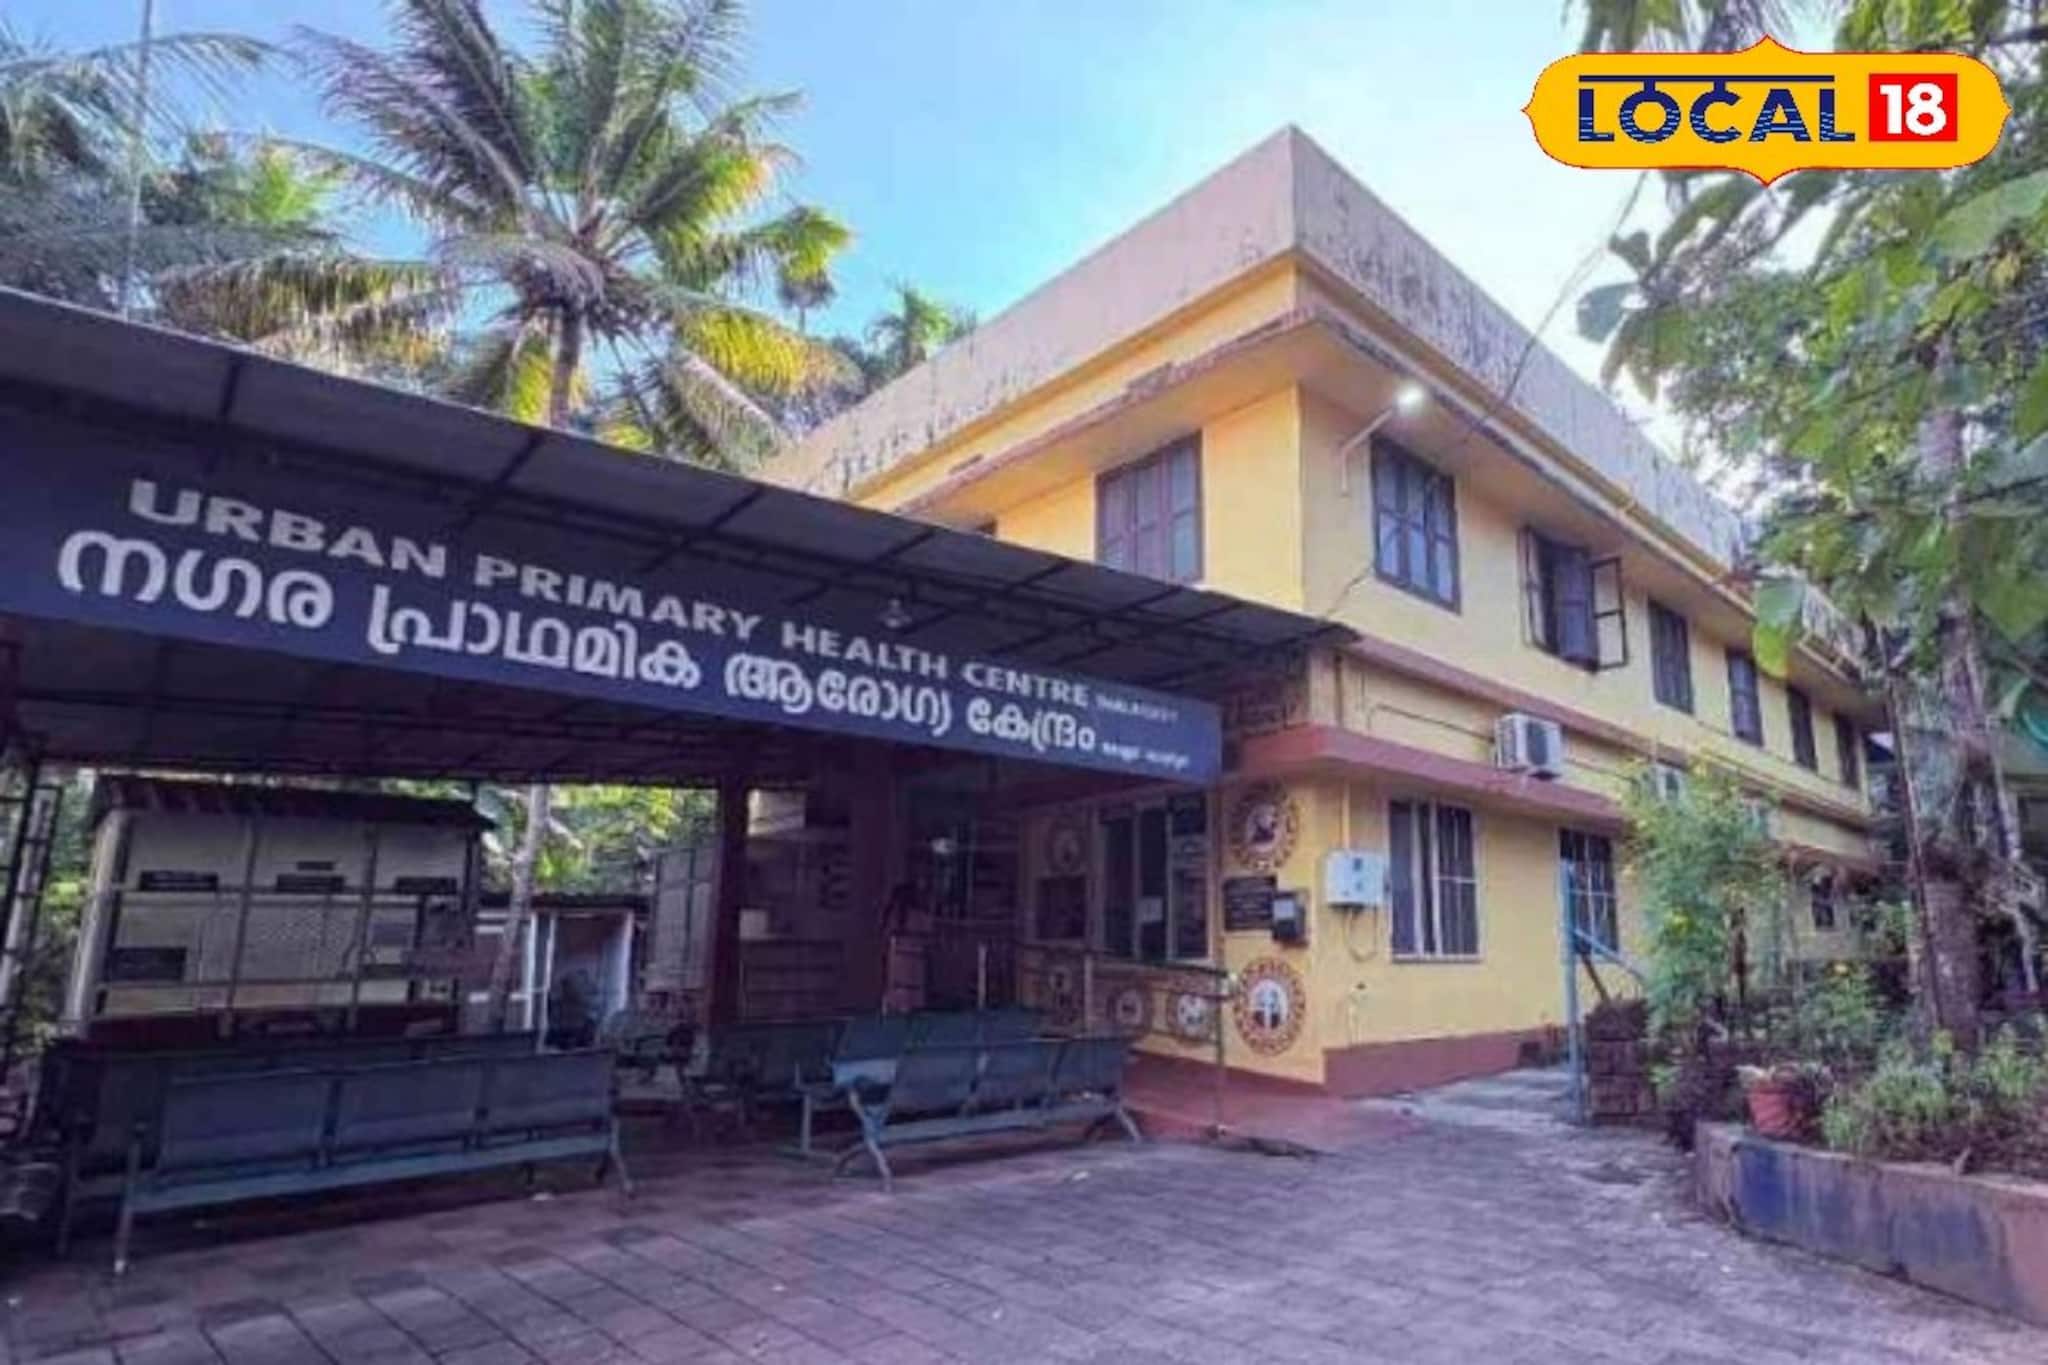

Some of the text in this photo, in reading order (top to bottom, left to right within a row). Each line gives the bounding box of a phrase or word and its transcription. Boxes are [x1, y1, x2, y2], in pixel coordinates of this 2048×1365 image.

[58, 530, 334, 628] നഗര
[367, 584, 700, 689] പ്രാഥമിക
[724, 653, 952, 735] ആരോഗ്യ
[131, 480, 446, 577] URBAN
[475, 555, 760, 639] PRIMARY
[782, 622, 948, 679] HEALTH
[961, 663, 1089, 708] CENTRE
